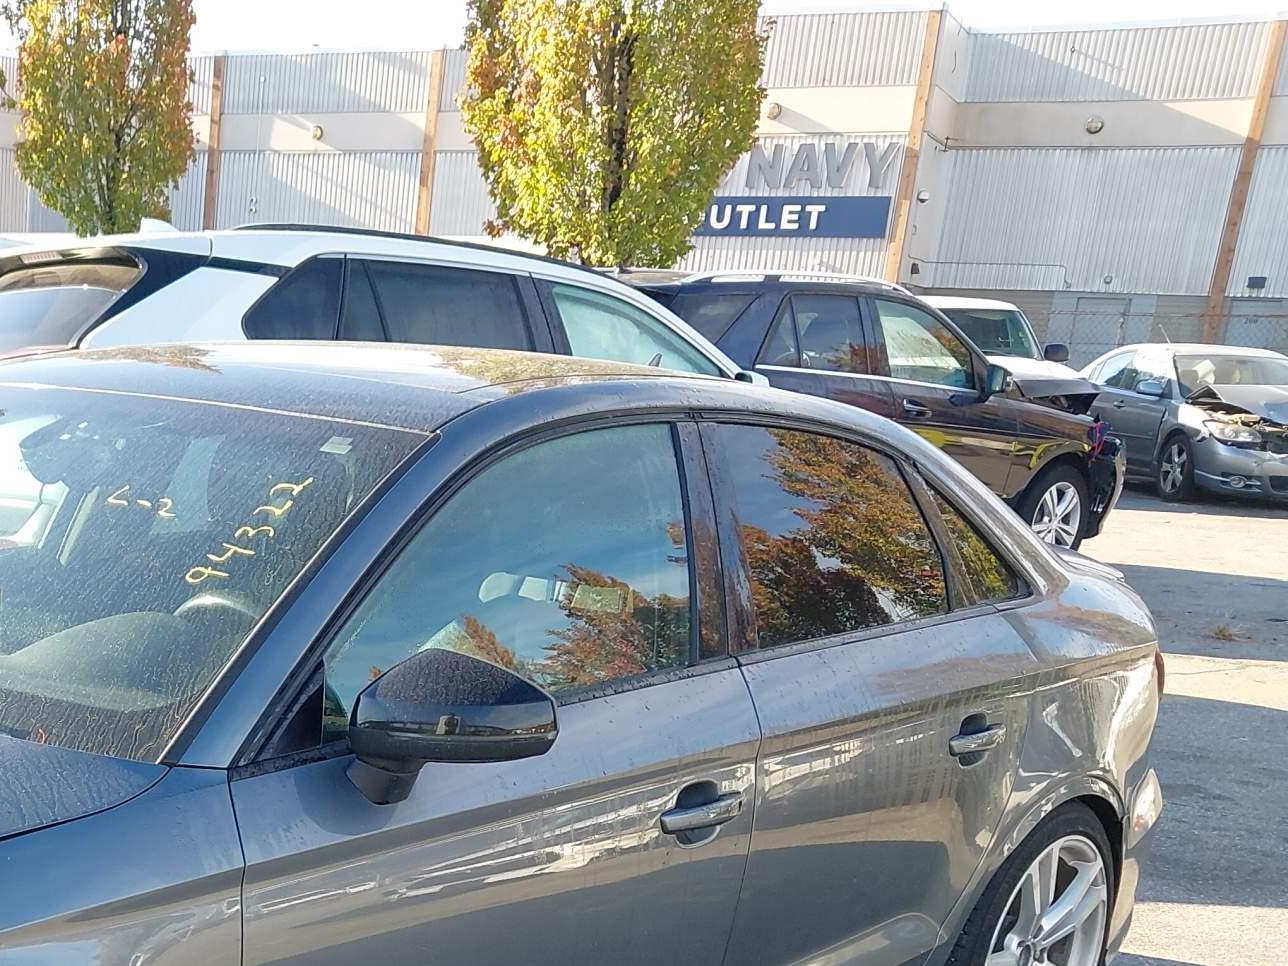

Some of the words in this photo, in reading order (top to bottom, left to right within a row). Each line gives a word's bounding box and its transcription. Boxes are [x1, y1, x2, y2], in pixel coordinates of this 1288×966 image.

[744, 141, 901, 189] NAVY
[700, 203, 827, 230] UTLET
[184, 476, 314, 584] 94322
